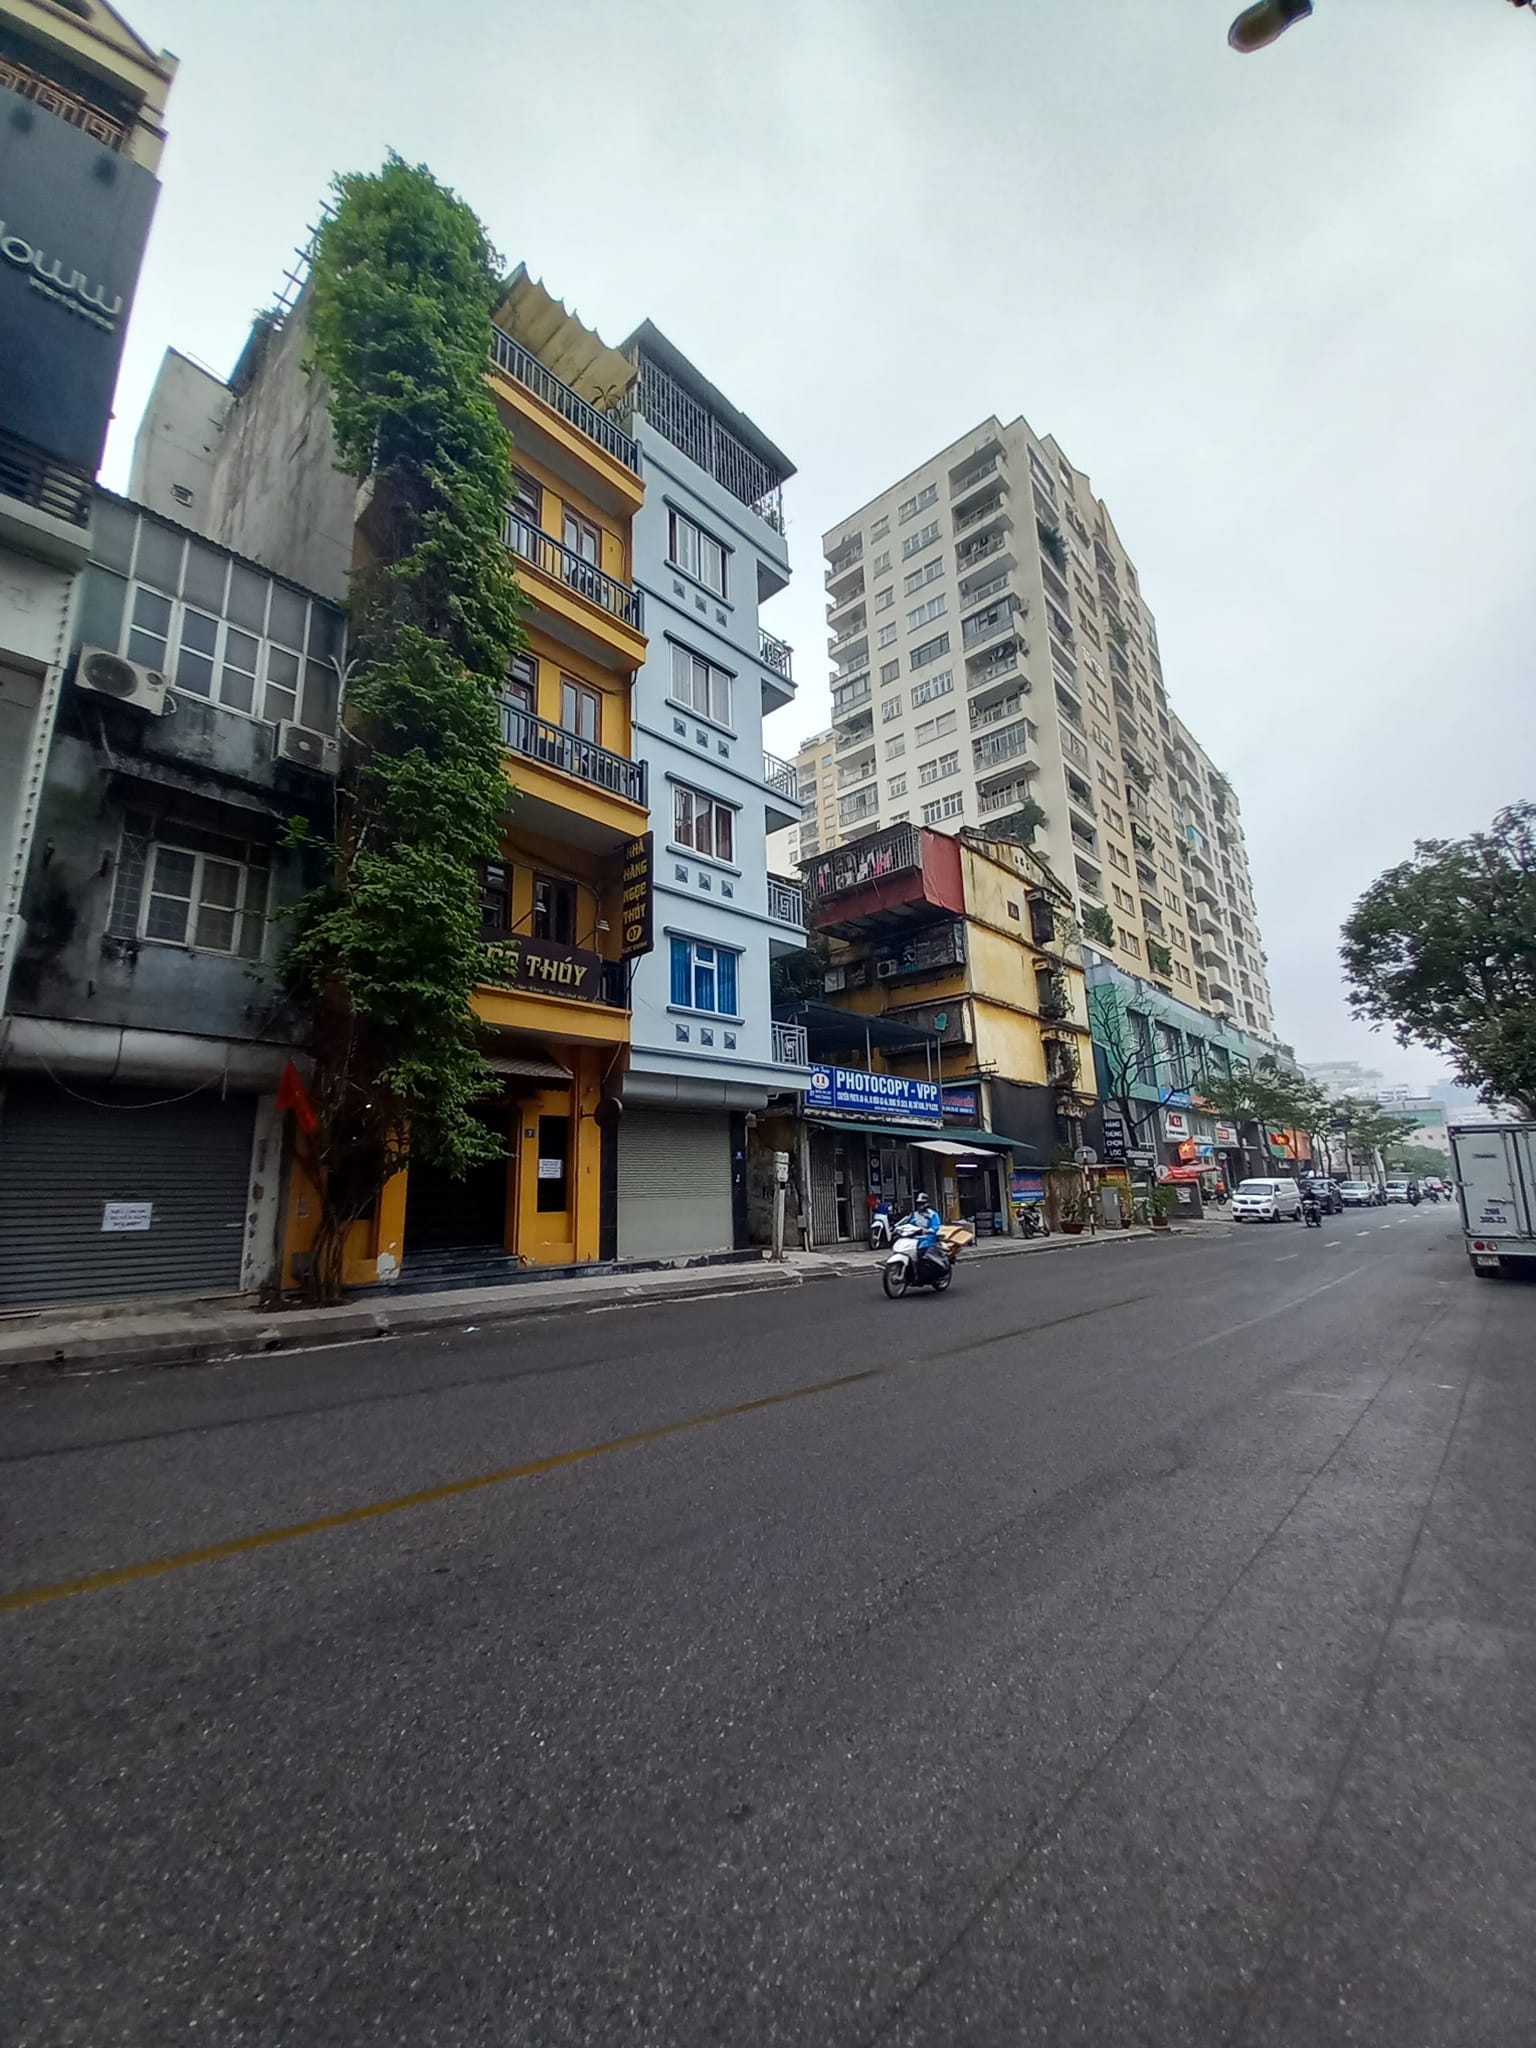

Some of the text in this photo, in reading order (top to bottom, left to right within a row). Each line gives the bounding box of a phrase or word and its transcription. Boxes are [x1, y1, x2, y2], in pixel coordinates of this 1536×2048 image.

[525, 956, 588, 987] THÚY
[836, 1069, 909, 1098] PHOTOCOPY
[916, 1082, 938, 1101] VPP
